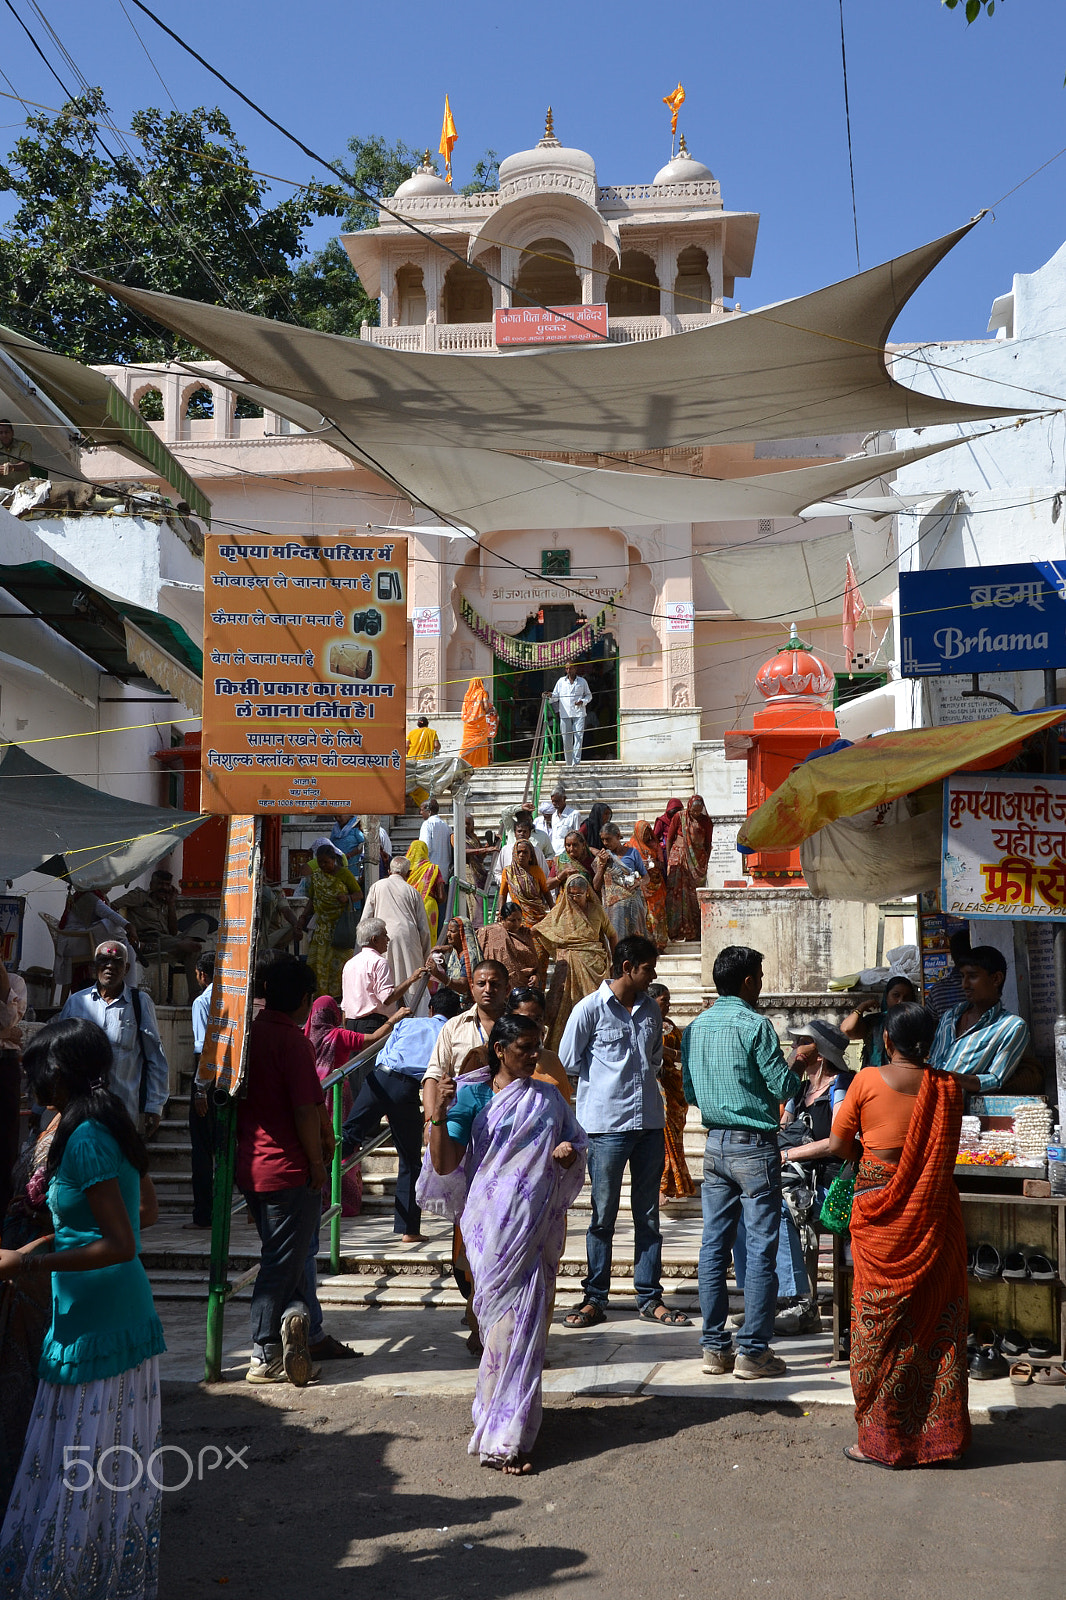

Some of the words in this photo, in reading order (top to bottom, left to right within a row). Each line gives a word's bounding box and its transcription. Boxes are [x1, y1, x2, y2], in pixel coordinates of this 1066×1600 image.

[500, 314, 521, 324] जगत
[523, 311, 540, 323] पिता
[219, 544, 270, 562] कृपया
[272, 543, 321, 561] मन्दिर
[323, 543, 374, 561] परिसर
[378, 544, 394, 562] में
[211, 572, 270, 589] मोबाइल
[273, 573, 289, 589] ले
[292, 575, 328, 589] जाना
[330, 577, 359, 590] मना
[361, 574, 372, 591] है
[211, 608, 250, 625] कैमरा
[252, 610, 267, 626] ले
[269, 612, 302, 626] जाना
[305, 614, 333, 627] मना
[334, 611, 345, 629] है
[934, 627, 1049, 659] Brhama
[210, 649, 230, 665] बेग
[233, 649, 248, 665] ले
[249, 652, 278, 665] जाना
[280, 653, 303, 666] मना
[305, 650, 315, 667] है
[214, 678, 260, 697] किसी
[263, 681, 311, 697] प्रकार
[313, 682, 337, 697] का
[340, 683, 395, 698] सामान
[235, 700, 252, 718] ले
[256, 703, 300, 718] जाना
[303, 701, 352, 719] वर्जित
[246, 732, 285, 747] सामान
[288, 729, 317, 747] रखने
[320, 729, 335, 747] के
[337, 729, 362, 748] लिये
[207, 749, 253, 771] निशुल्क
[256, 750, 294, 768] क्लॉक
[297, 753, 319, 768] रूम
[321, 750, 339, 768] की
[341, 753, 390, 769] व्यवस्था
[391, 750, 401, 770] है
[950, 790, 1001, 829] कृपया
[1002, 785, 1052, 823] अपने
[981, 857, 1038, 905] फ्री
[951, 901, 994, 913] PLEASE
[995, 903, 1020, 914] PUT
[1021, 904, 1046, 915] OFF
